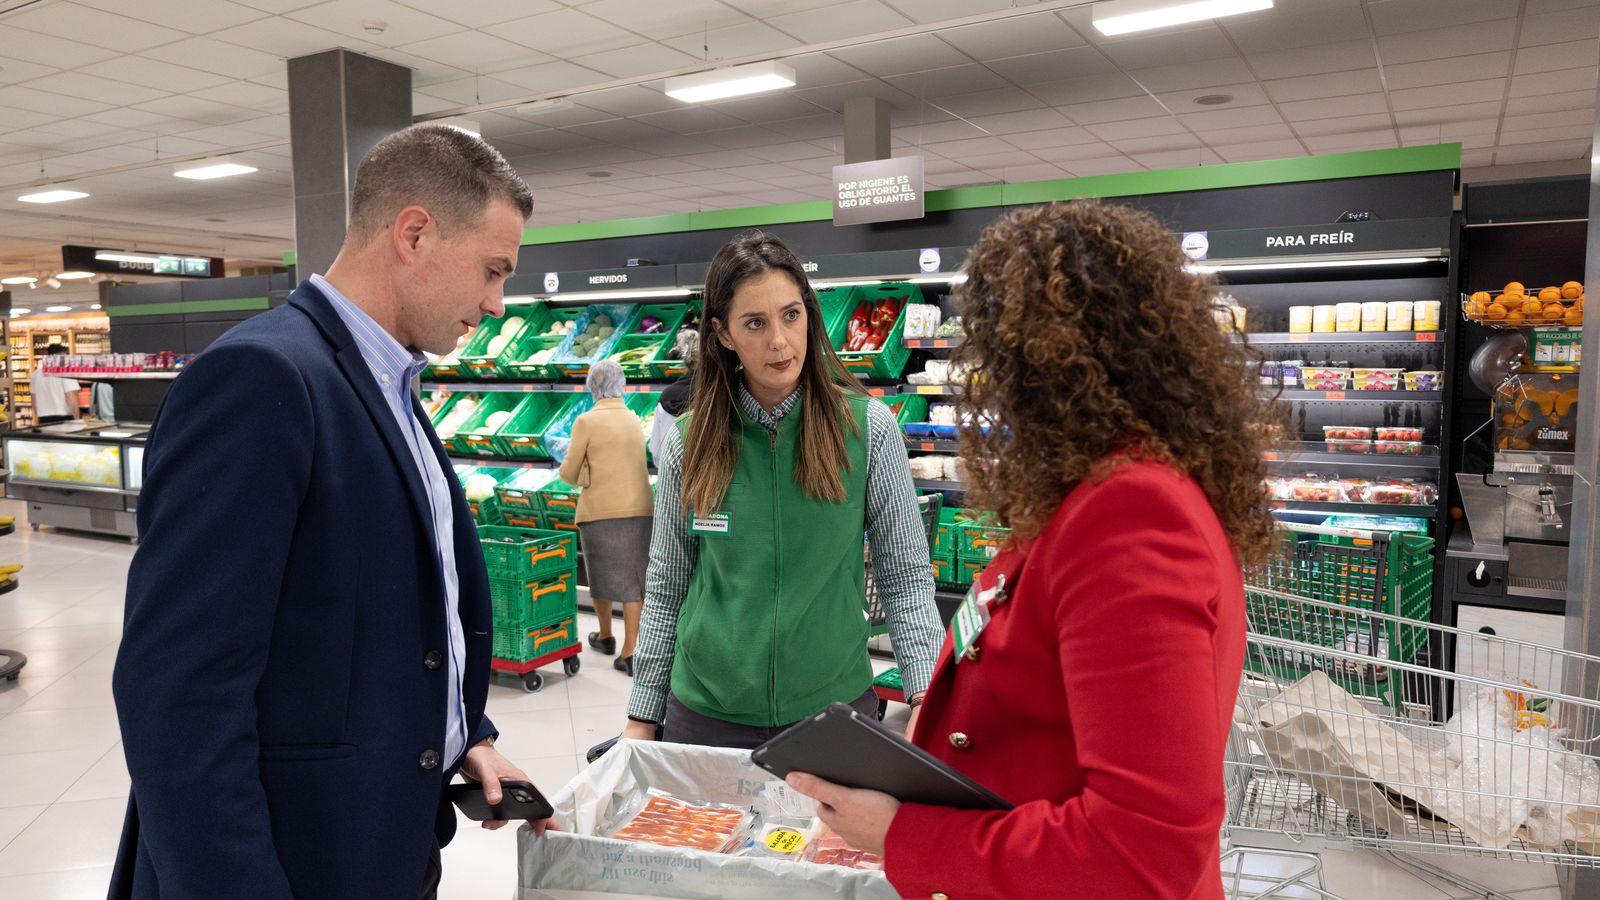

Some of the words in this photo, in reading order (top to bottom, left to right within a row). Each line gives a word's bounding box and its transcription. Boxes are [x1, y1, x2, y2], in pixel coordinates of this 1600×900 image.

[838, 182, 857, 191] POR
[858, 177, 895, 188] HIGIENE
[897, 175, 909, 184] ES
[838, 185, 900, 200] OBLIGATORIO
[901, 184, 913, 193] EL
[838, 200, 858, 208] USO
[858, 197, 872, 206] DE
[873, 192, 916, 204] GUANTES
[1266, 235, 1306, 248] PARA
[1310, 230, 1354, 245] FREÍR
[802, 261, 819, 273] EÍR
[589, 274, 628, 284] HERVIDOS
[769, 831, 787, 848] BAJADA
